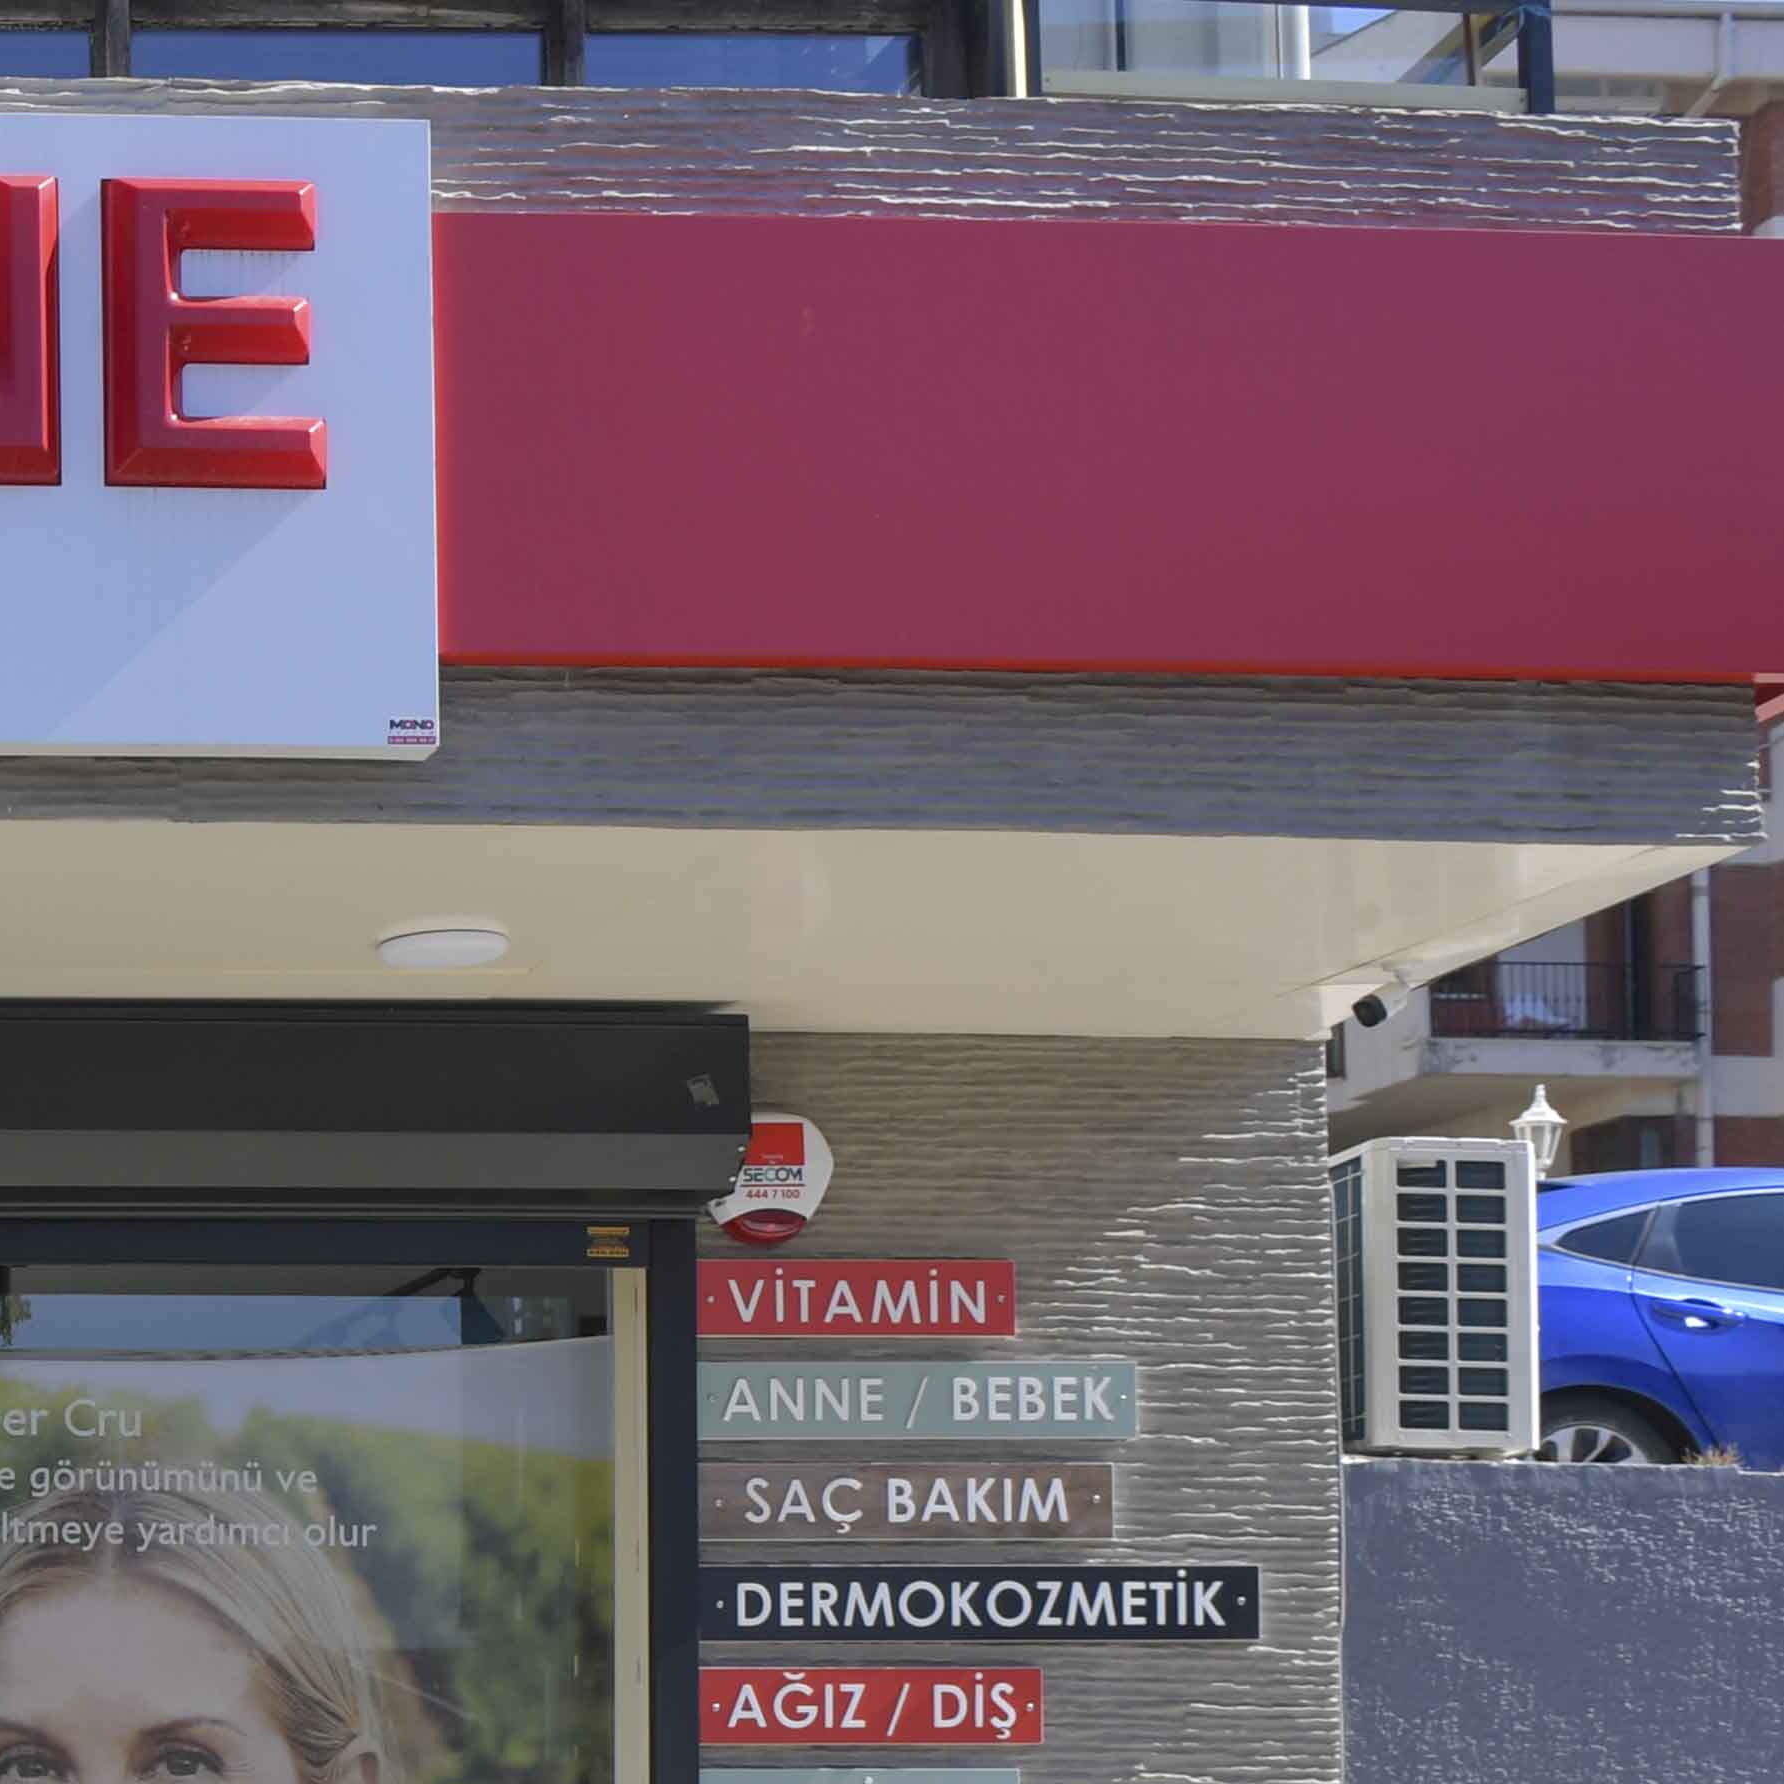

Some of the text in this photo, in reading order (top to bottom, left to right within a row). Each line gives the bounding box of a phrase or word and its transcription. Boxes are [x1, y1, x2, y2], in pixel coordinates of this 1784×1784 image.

[742, 1167, 803, 1182] SECOM
[746, 1189, 768, 1199] 444
[781, 1189, 801, 1199] 100
[728, 1267, 987, 1326] VİTAMİN
[65, 1399, 142, 1438] Cru
[723, 1376, 1113, 1429] ANNE / BEBEK
[30, 1461, 262, 1502] görünümünü
[277, 1470, 318, 1493] ve
[744, 1476, 1069, 1533] SAÇ BAKIM
[137, 1511, 291, 1552] yardımcı
[305, 1512, 377, 1548] olur
[736, 1568, 1225, 1629] DERMOKOZMETİK
[727, 1671, 1017, 1739] AĞIZ / DİŞ
